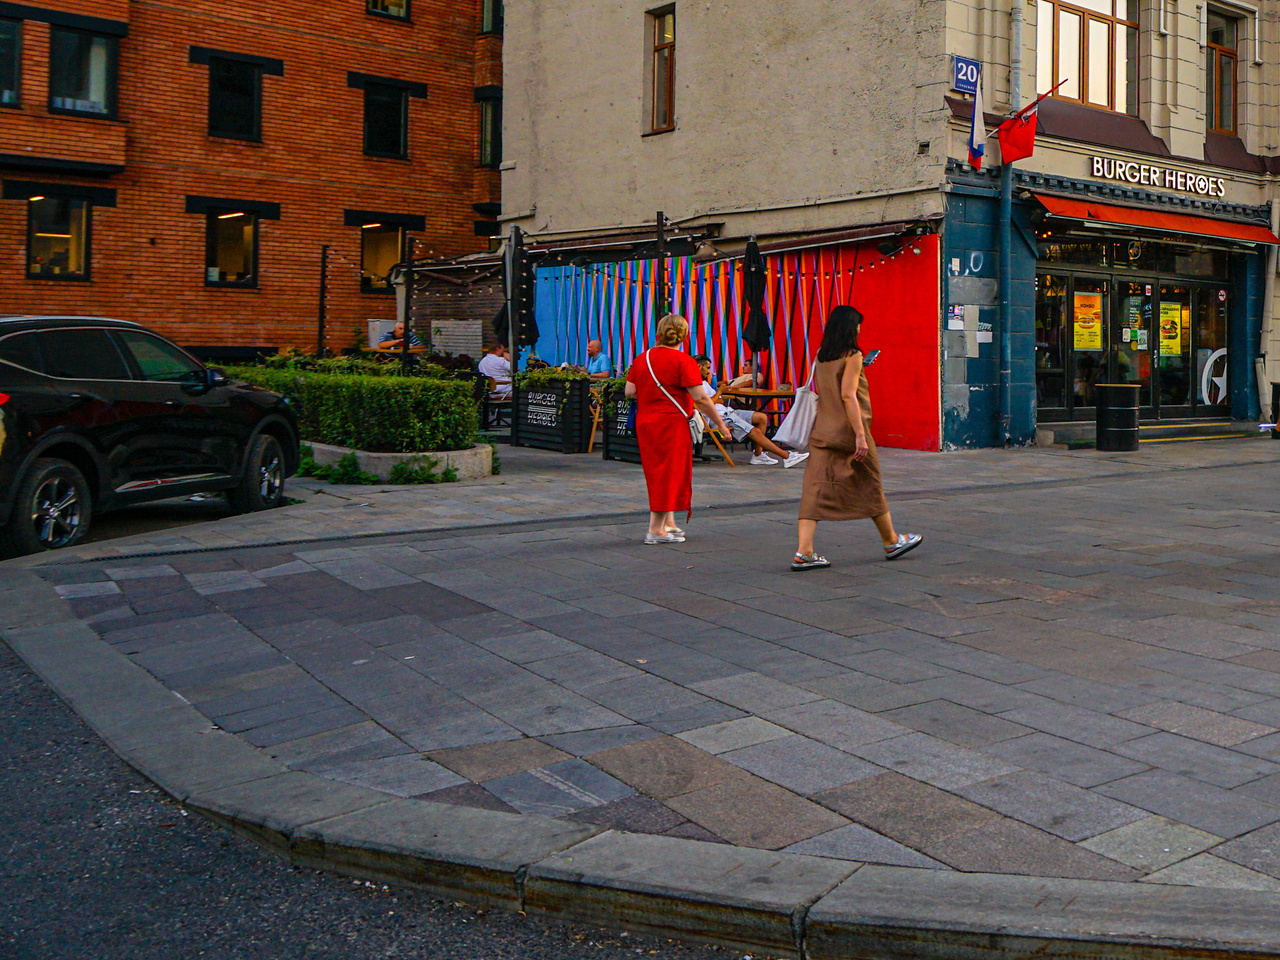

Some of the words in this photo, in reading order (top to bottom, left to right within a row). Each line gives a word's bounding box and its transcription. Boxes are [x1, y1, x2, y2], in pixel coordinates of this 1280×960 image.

[957, 62, 977, 83] 20
[1093, 156, 1160, 186] BURGER
[1165, 169, 1226, 197] HEROES
[528, 391, 556, 405] BURGER
[528, 411, 556, 427] HEROES
